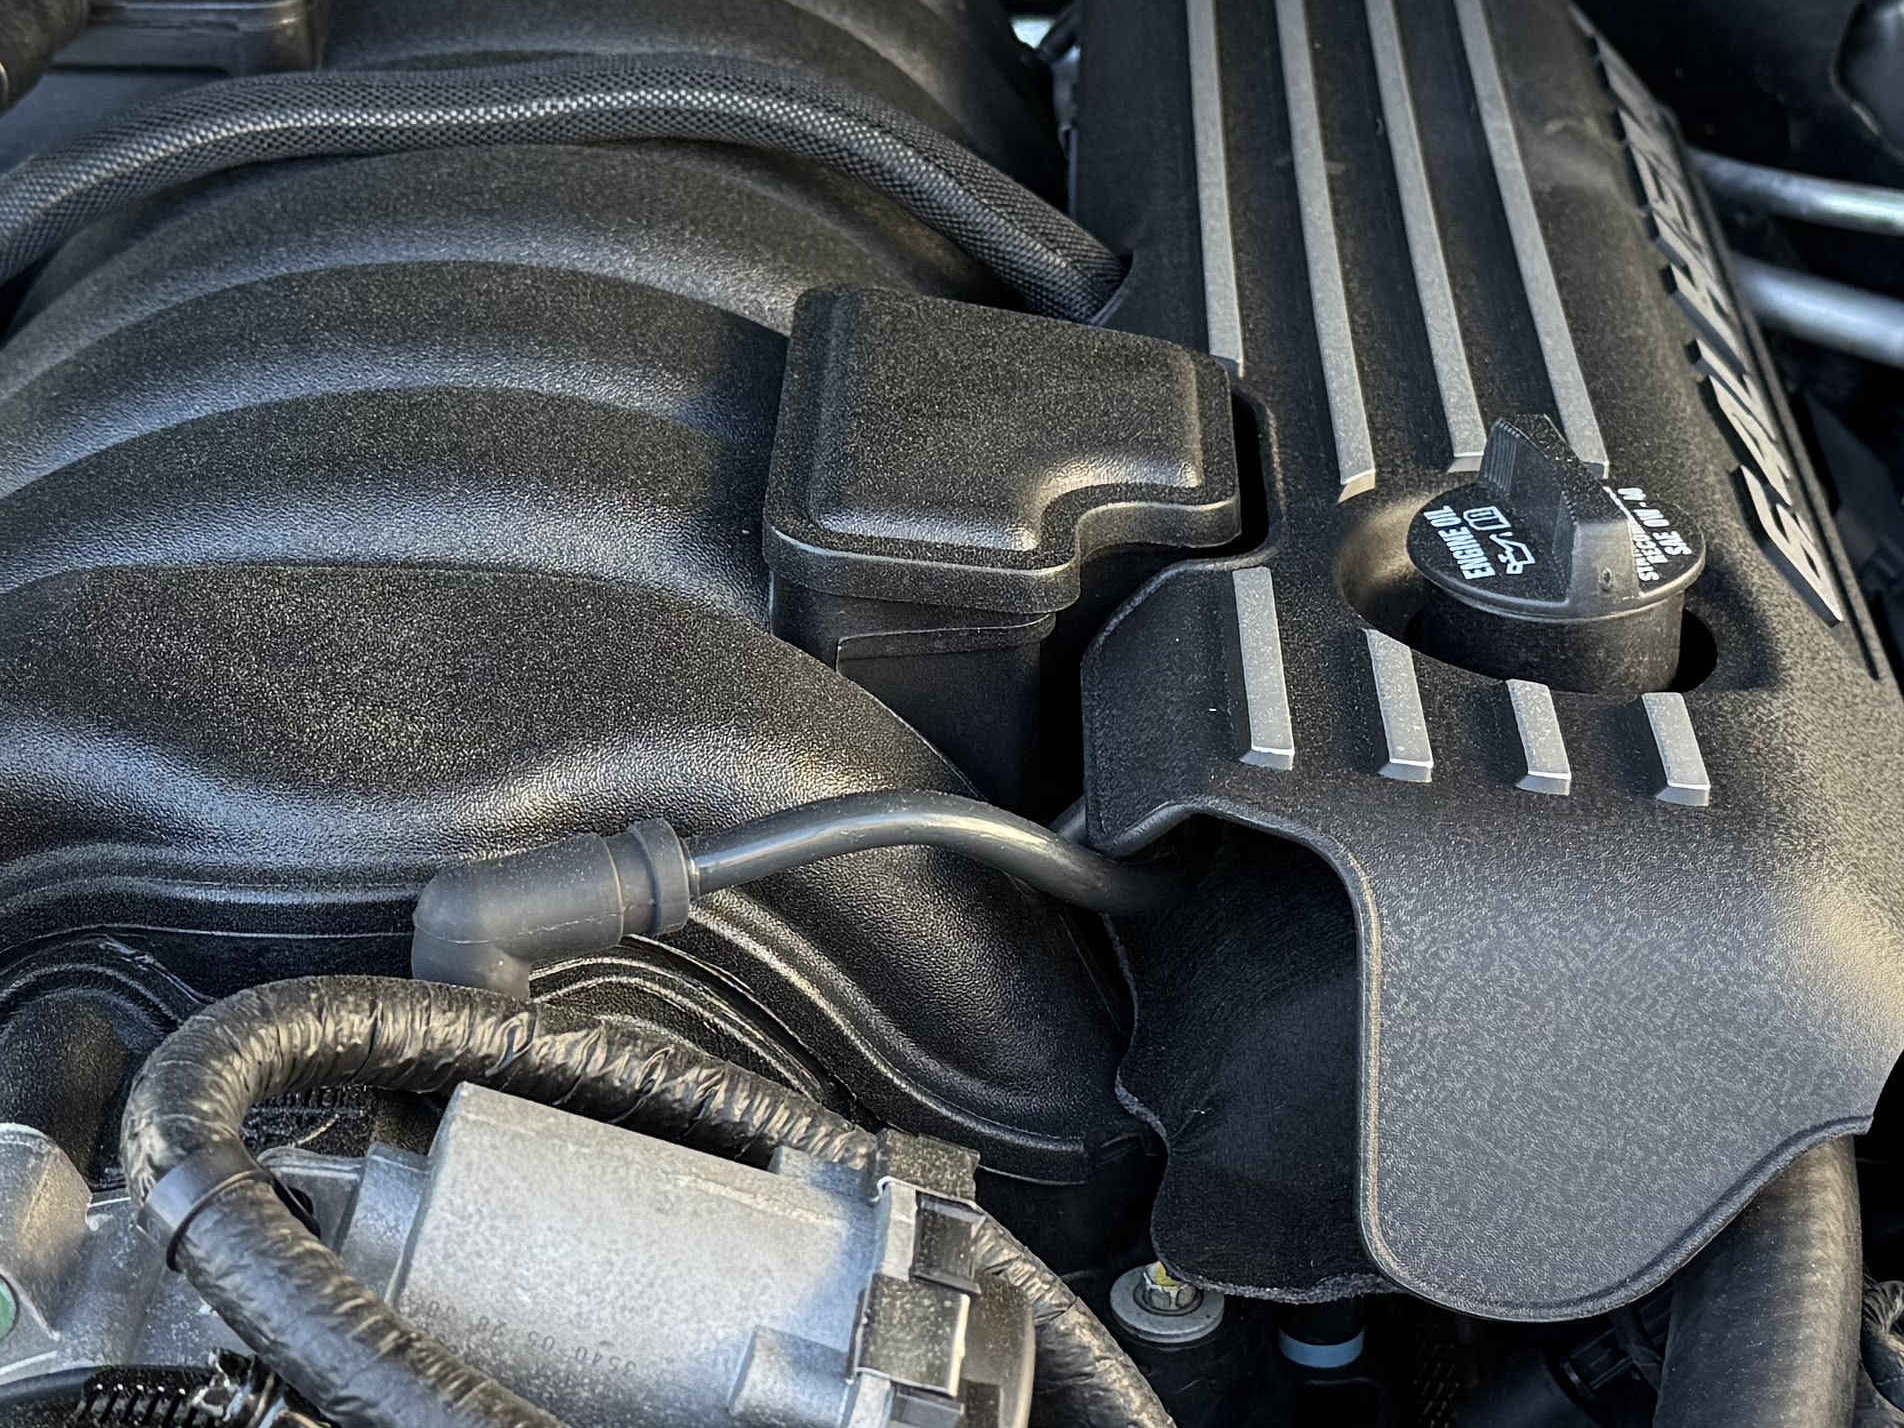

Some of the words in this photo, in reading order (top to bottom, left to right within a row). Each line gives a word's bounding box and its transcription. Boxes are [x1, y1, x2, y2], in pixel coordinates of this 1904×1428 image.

[1423, 505, 1462, 531] OIL
[1437, 525, 1496, 580] ENGINE
[1652, 530, 1693, 556] SAE
